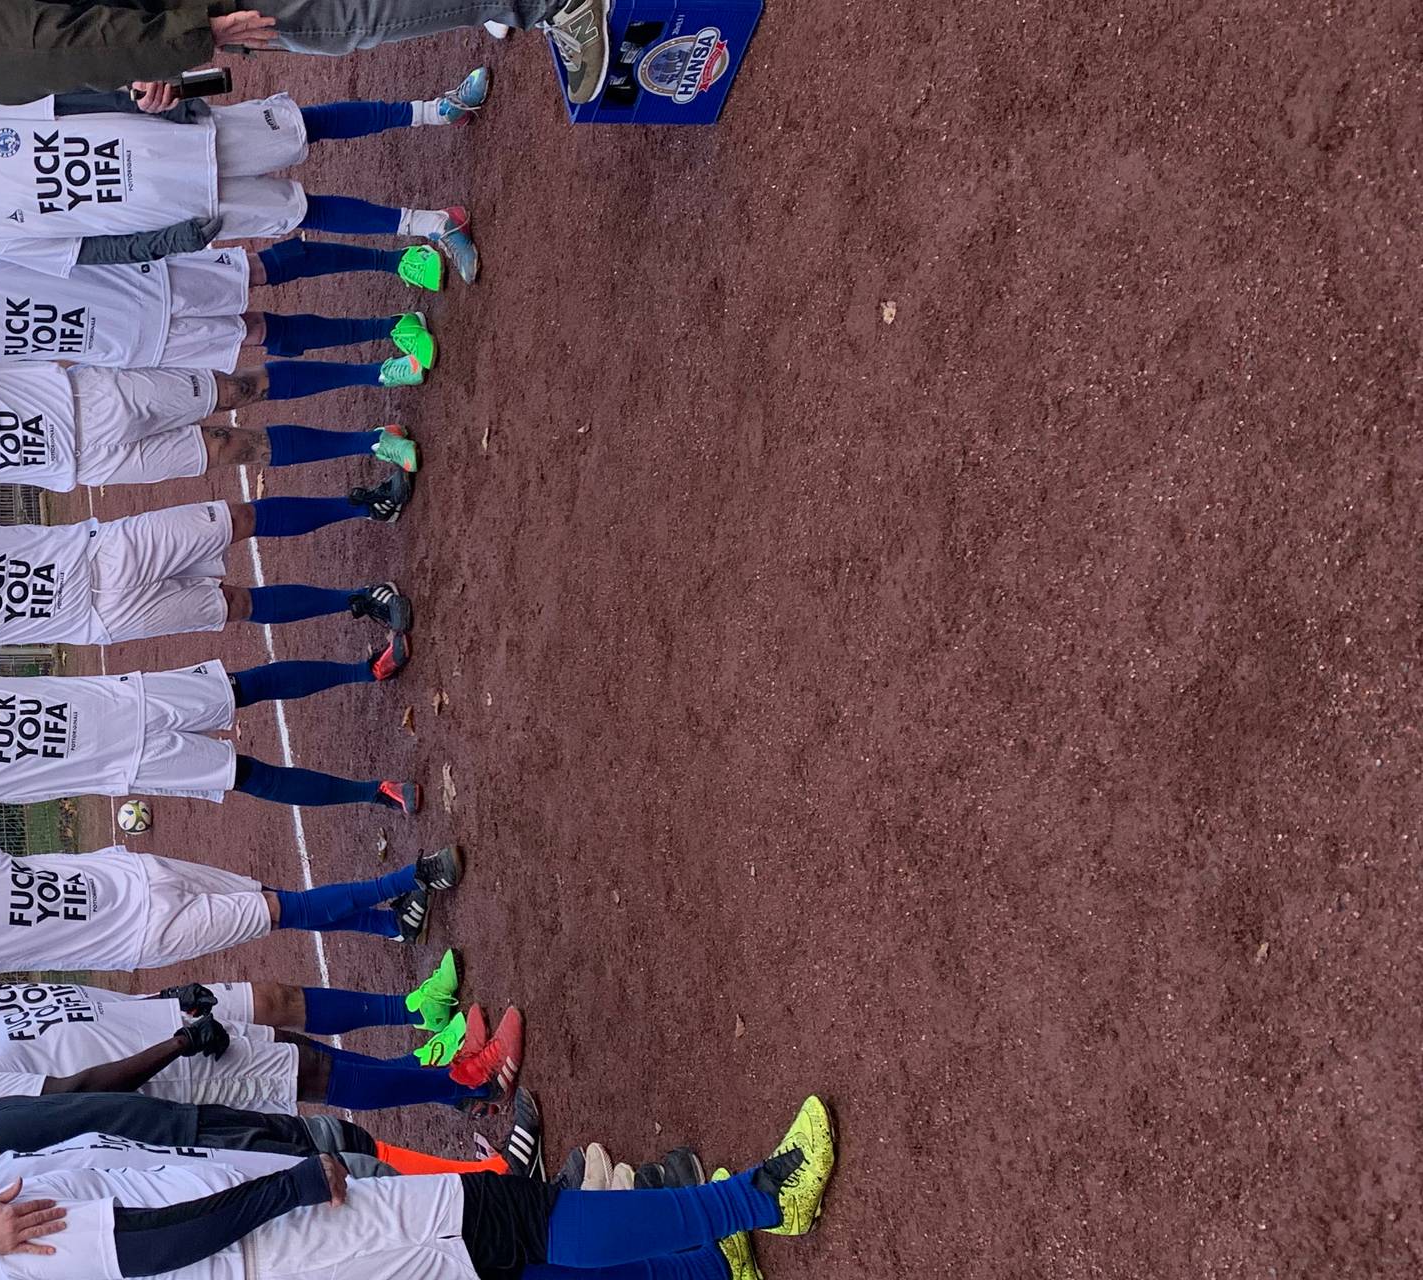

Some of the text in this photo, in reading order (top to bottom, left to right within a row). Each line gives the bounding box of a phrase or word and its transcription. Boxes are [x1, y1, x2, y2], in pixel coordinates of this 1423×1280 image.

[677, 35, 715, 95] HANSA
[33, 130, 64, 214] FUCK
[64, 138, 92, 211] YOU
[94, 139, 122, 203] FIFA
[4, 297, 30, 356] FUCK
[31, 304, 57, 353] YOU
[58, 307, 85, 352] FIFA
[22, 414, 45, 465] FIFA
[4, 560, 31, 623] YOU
[30, 564, 55, 618] FIFA
[16, 699, 42, 760] YOU
[42, 703, 68, 758] FIFA
[9, 860, 34, 926] FUCK
[37, 871, 60, 924] YOU
[63, 873, 87, 920] FIFA
